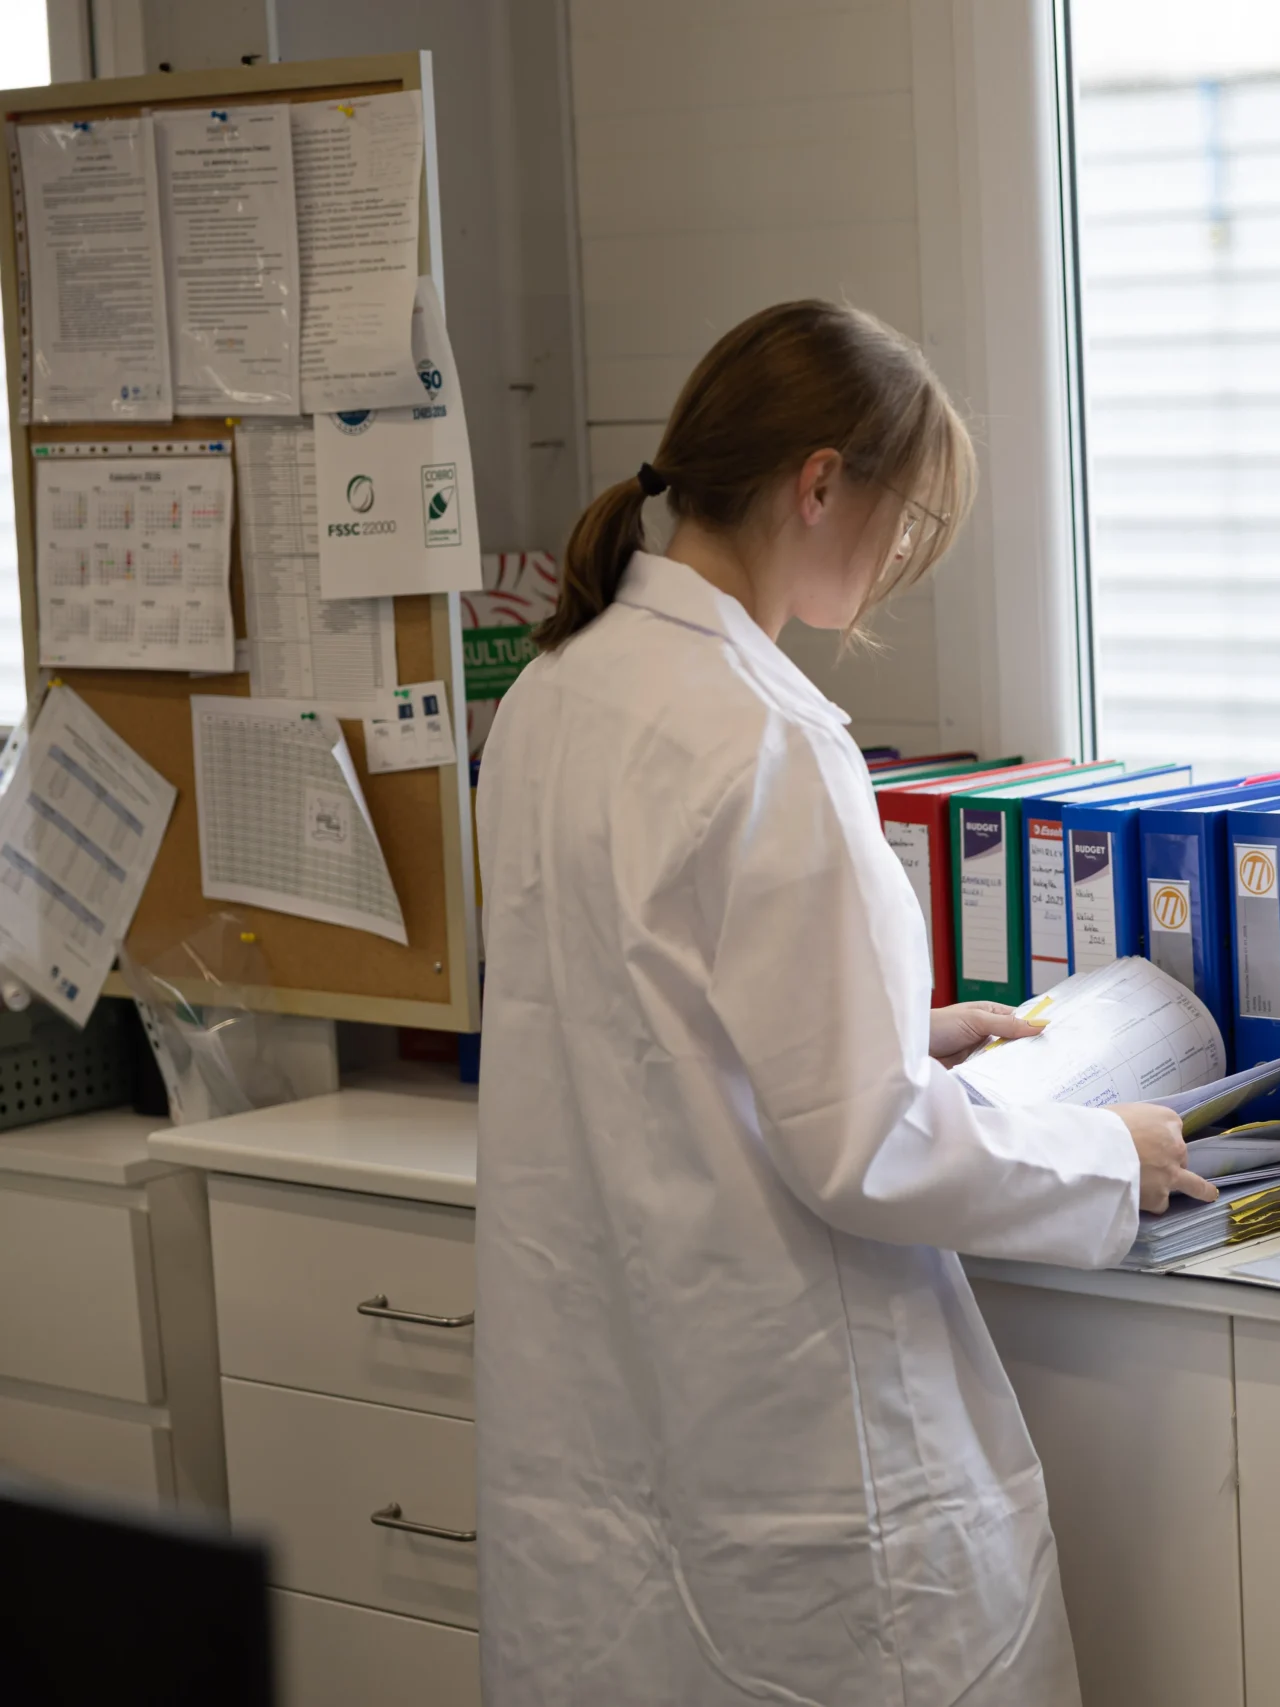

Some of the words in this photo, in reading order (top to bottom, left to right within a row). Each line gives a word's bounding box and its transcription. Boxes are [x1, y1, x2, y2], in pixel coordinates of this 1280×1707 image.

[328, 522, 360, 537] FSSC
[362, 520, 397, 535] 22000
[966, 821, 999, 833] BUDGET
[1074, 844, 1106, 855] BUDGET
